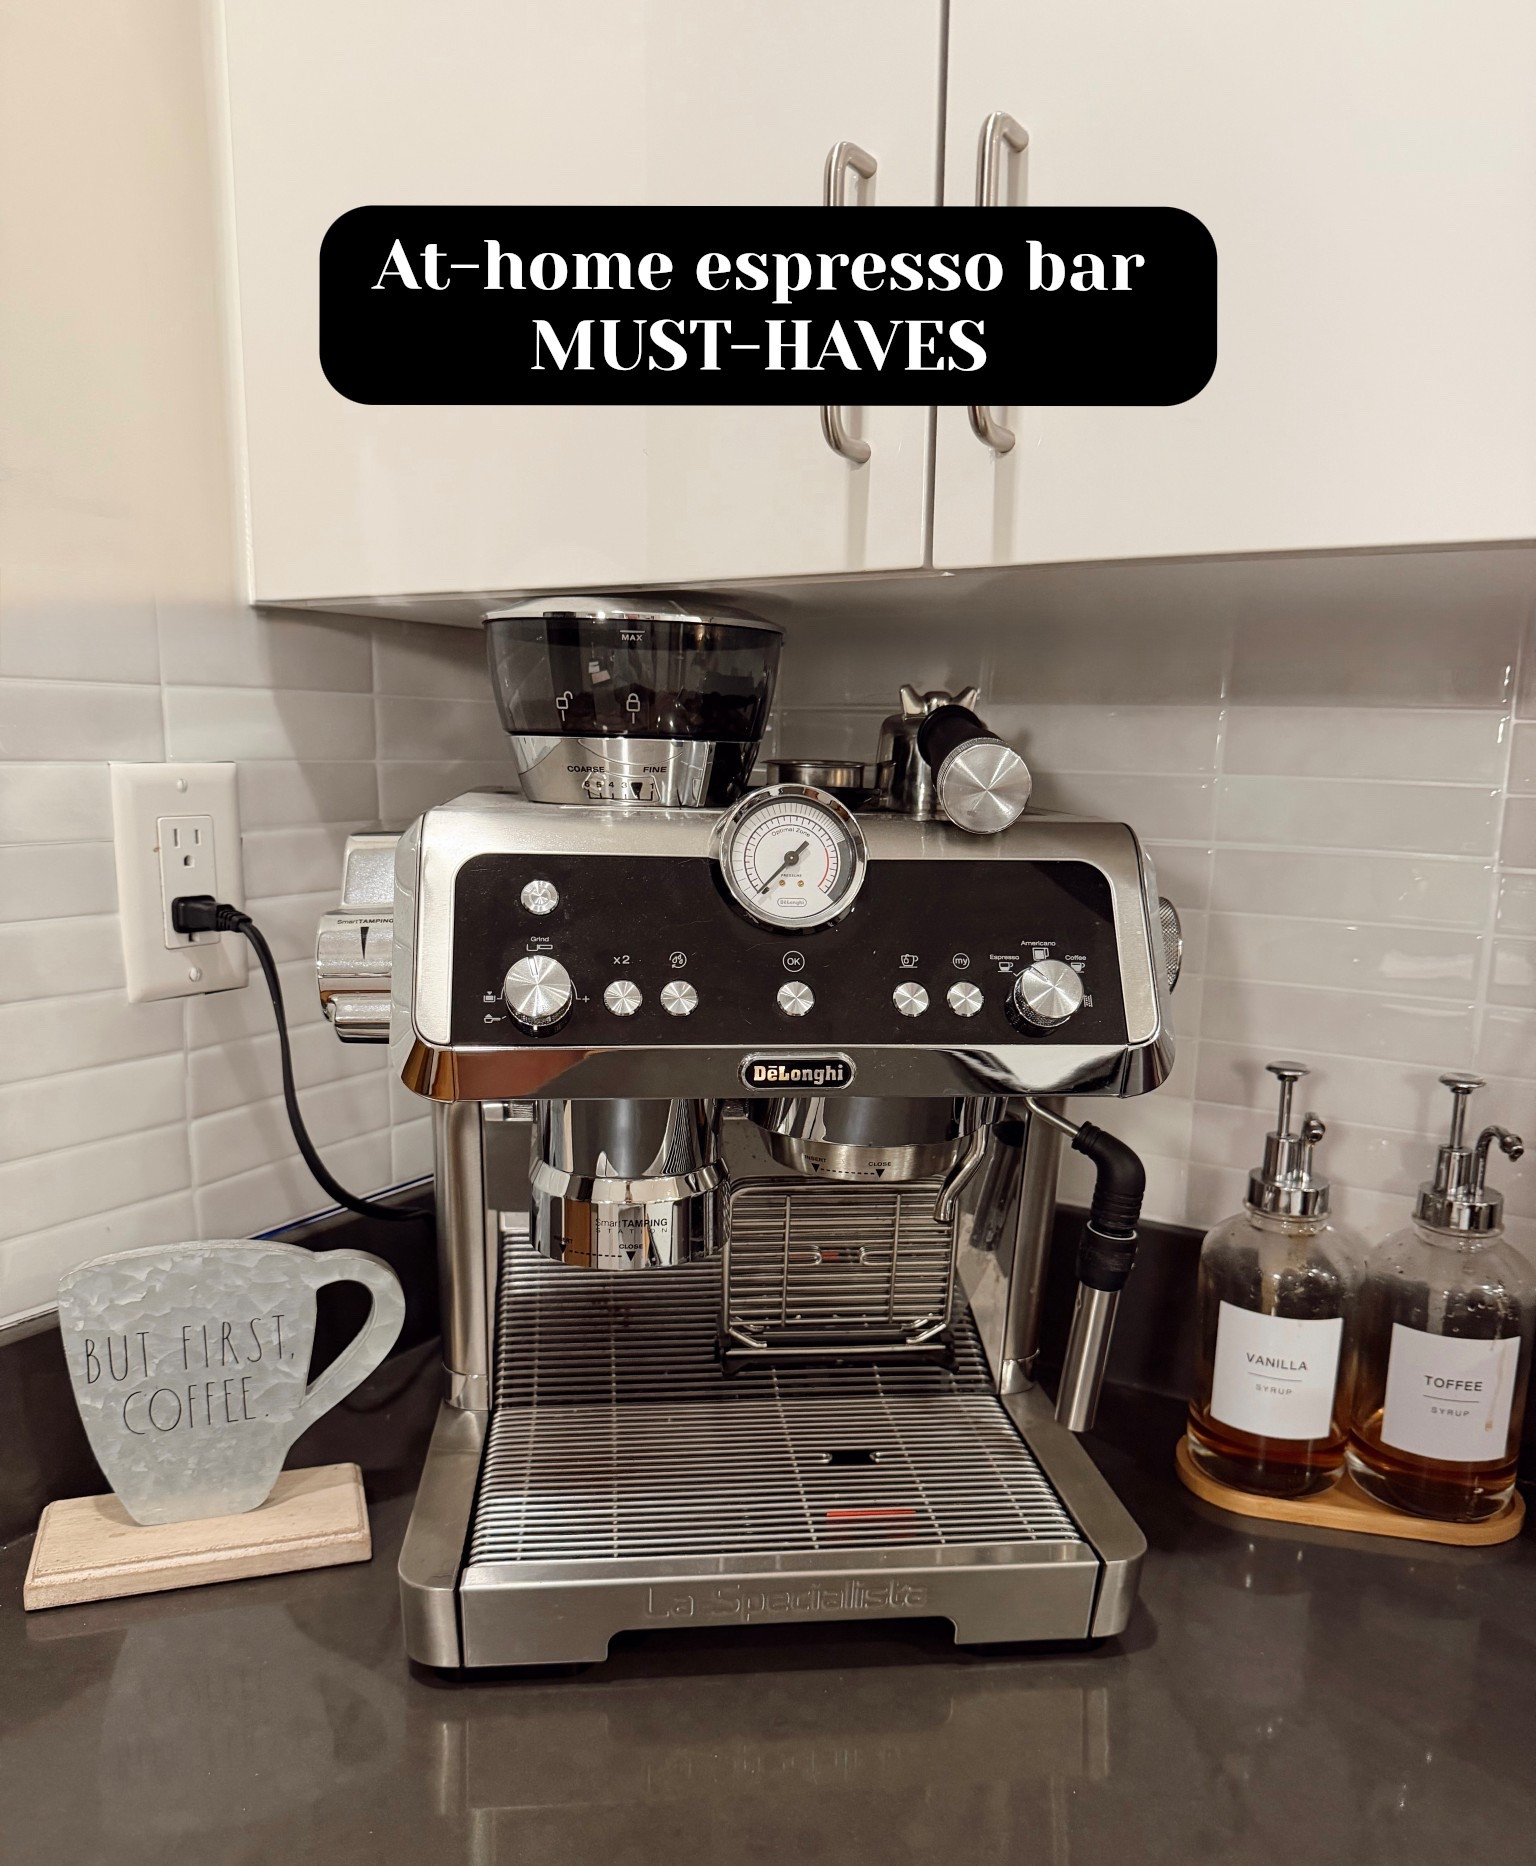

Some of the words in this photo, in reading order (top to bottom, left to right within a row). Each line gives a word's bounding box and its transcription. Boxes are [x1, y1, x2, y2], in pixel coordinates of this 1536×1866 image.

[621, 633, 643, 641] MAX
[567, 765, 605, 773] COARSE
[771, 827, 795, 837] Optimal
[795, 828, 811, 838] Zone
[613, 954, 631, 965] x2
[786, 957, 801, 966] OK
[954, 957, 968, 967] my
[989, 953, 1020, 961] Espresso
[804, 1154, 827, 1163] INSERT
[84, 1331, 150, 1385] BUT
[182, 1314, 295, 1371] FIRST,
[1245, 1352, 1309, 1372] VANILLA
[1423, 1374, 1484, 1393] TOFFEE
[1255, 1383, 1293, 1396] SYRUP
[122, 1375, 270, 1435] COFFEE.
[1430, 1406, 1471, 1418] SYRUP
[645, 1587, 694, 1618] La
